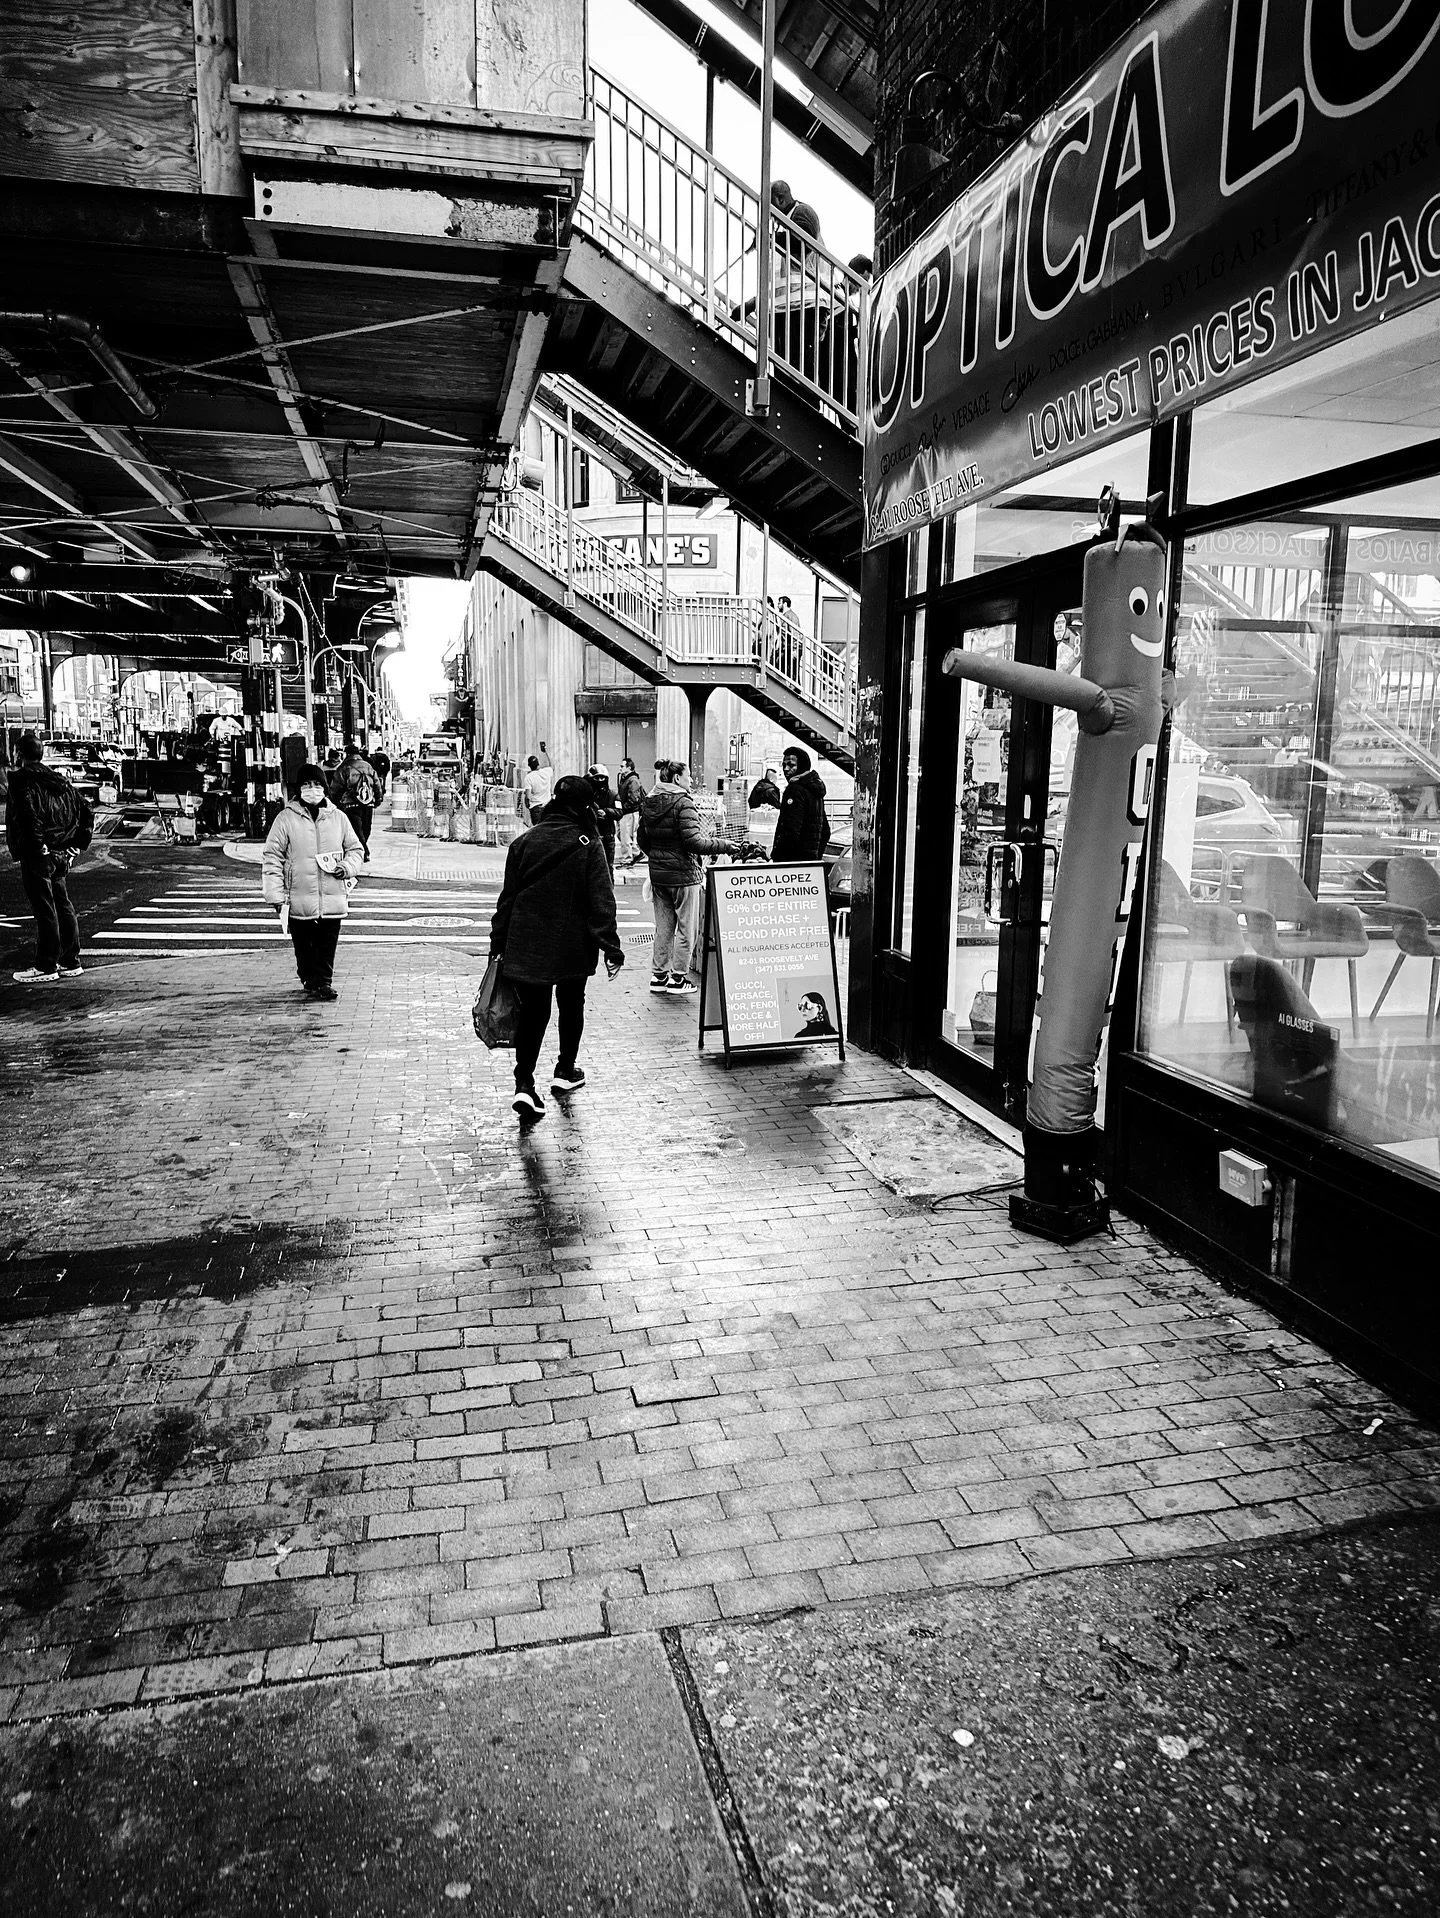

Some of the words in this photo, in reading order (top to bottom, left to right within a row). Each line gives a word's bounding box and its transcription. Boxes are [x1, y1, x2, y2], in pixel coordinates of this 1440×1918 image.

[867, 30, 1176, 434] OPTICA
[1027, 358, 1141, 462] LOWEST
[1148, 286, 1276, 406] PRICES
[1287, 250, 1341, 341] IN
[952, 391, 991, 431] VERSACE
[890, 442, 912, 467] GUCCI
[956, 461, 985, 498] AVE.
[730, 875, 772, 886] OPTICA
[775, 873, 812, 884] LOPEZ
[725, 888, 766, 900] GRAND
[769, 886, 819, 898] OPENING
[726, 903, 749, 914] 50%
[752, 902, 775, 913] OFF
[777, 900, 818, 911] ENTIRE
[738, 914, 800, 926] PURCHASE
[721, 928, 769, 941] SECOND
[771, 927, 797, 938] PAIR
[799, 925, 829, 936] FREE
[727, 946, 741, 954] ALL
[742, 943, 790, 953] INSURANCES
[790, 941, 829, 949] ACCEPTED
[759, 955, 804, 965] ROOSEVELT
[804, 953, 819, 961] AVE
[734, 981, 765, 990] GUCCI,
[728, 990, 773, 1001] VERSACE,
[733, 1011, 764, 1021] DOLCE
[765, 1011, 773, 1019] &
[728, 1021, 755, 1032] MORE
[756, 1020, 779, 1030] HALF
[1278, 1012, 1286, 1025] AI
[1285, 1013, 1314, 1034] GLASSES
[744, 1031, 765, 1041] OFF!
